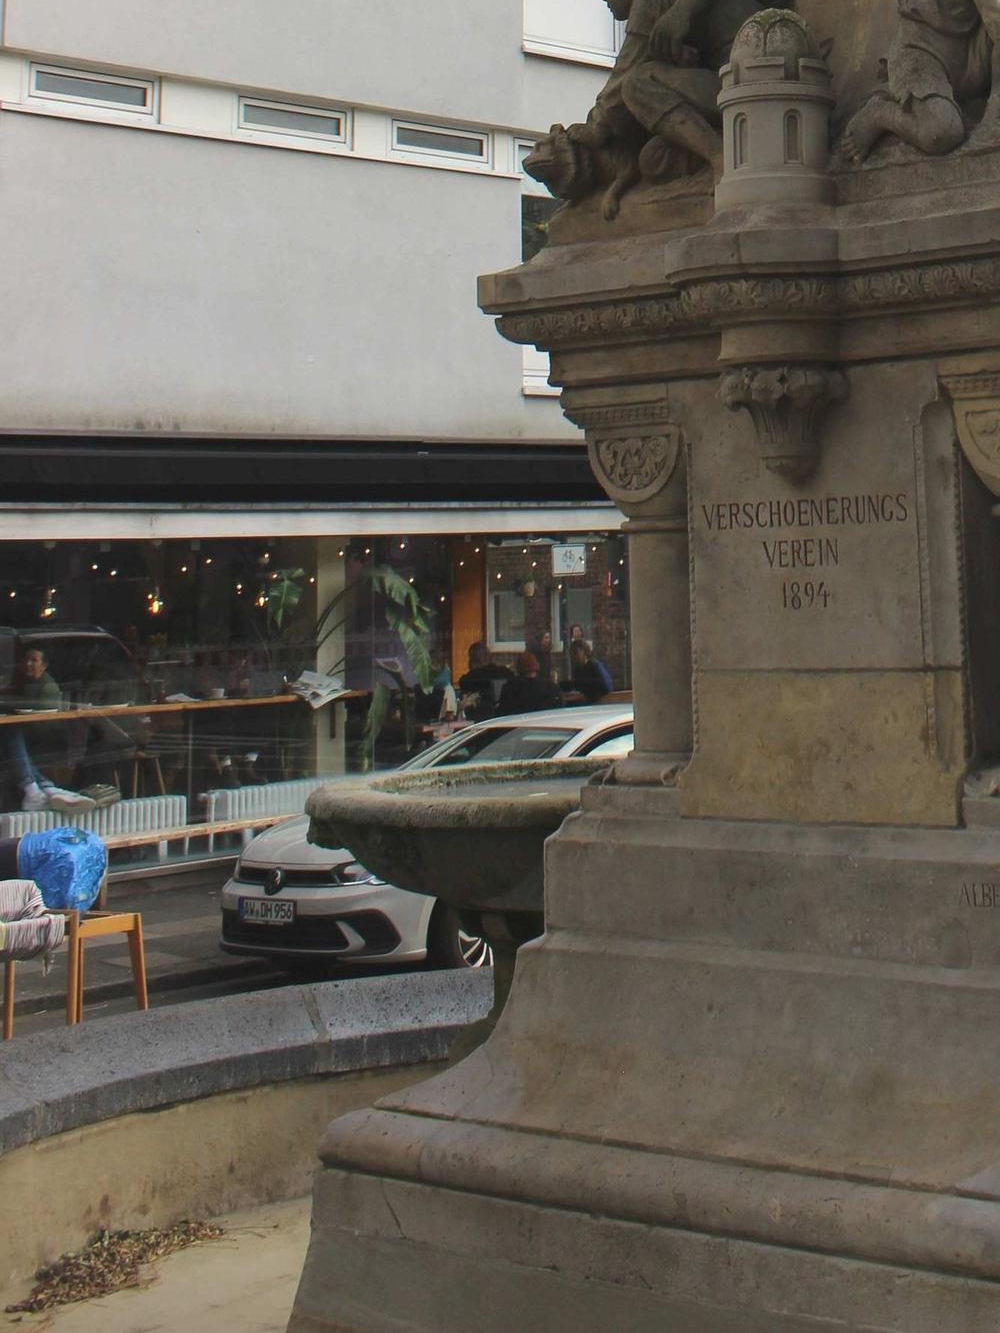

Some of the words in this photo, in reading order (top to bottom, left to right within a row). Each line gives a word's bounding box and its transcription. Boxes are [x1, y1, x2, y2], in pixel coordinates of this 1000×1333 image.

[701, 493, 908, 531] VERSCHOENERUNGS
[762, 538, 840, 568] VEREIN
[783, 581, 831, 610] 1894
